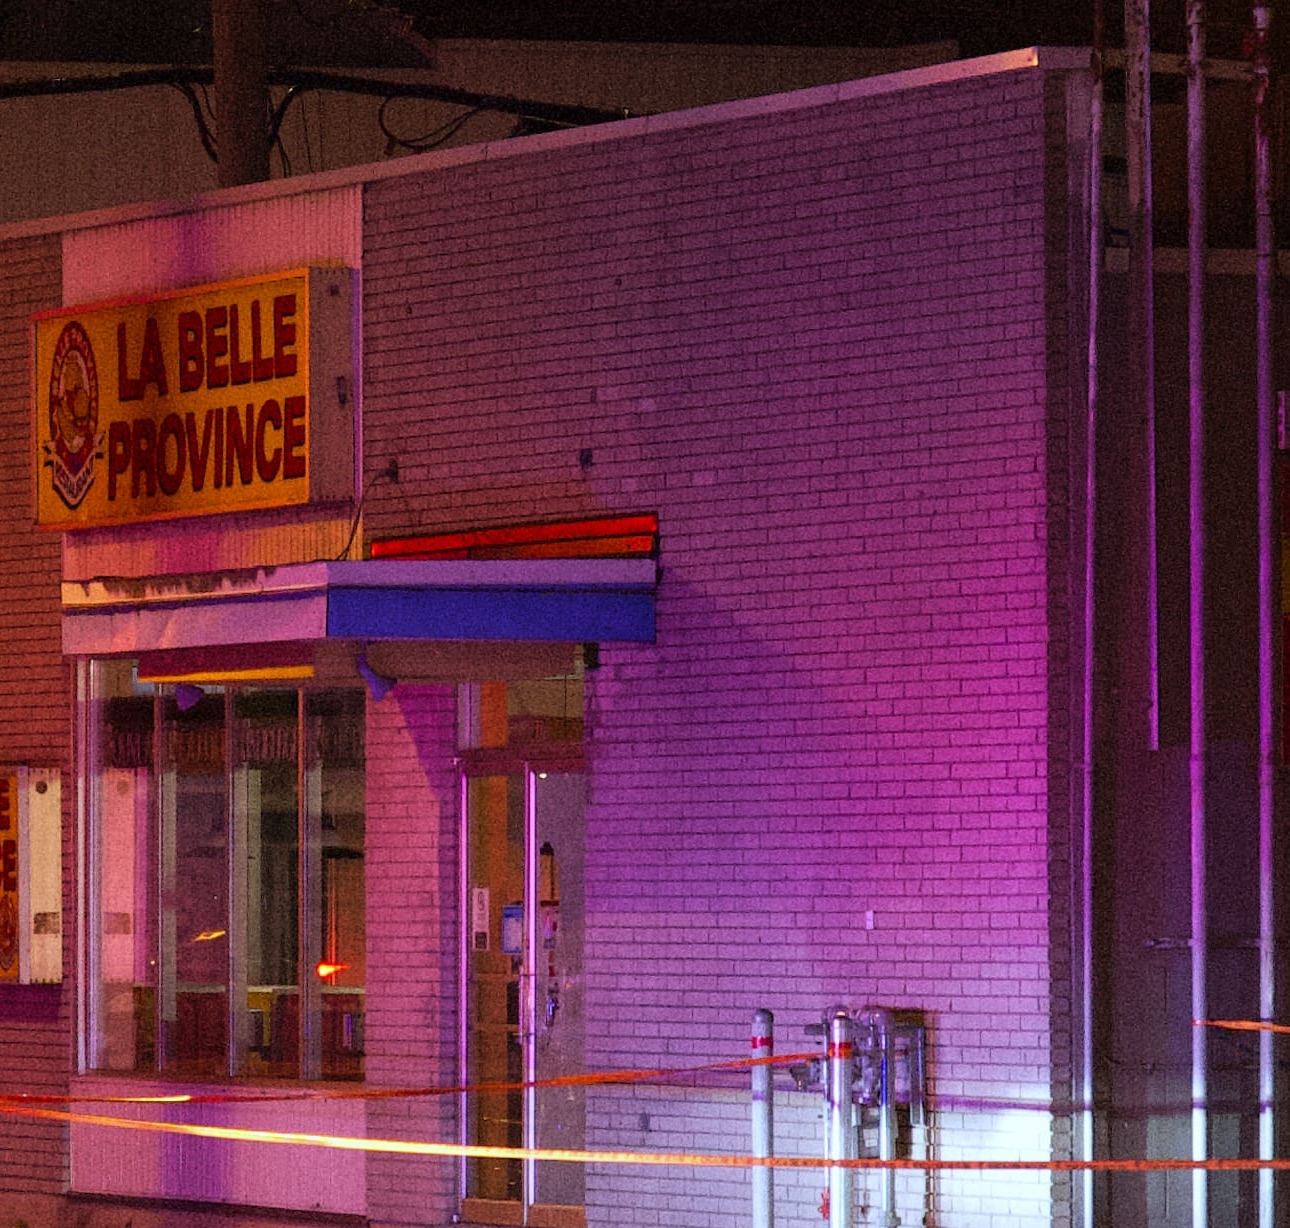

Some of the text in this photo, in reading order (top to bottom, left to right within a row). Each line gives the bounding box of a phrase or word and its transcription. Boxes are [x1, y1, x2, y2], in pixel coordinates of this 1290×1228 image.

[117, 318, 167, 402] LA
[178, 294, 297, 394] BELLE
[108, 395, 306, 501] PROVINCE
